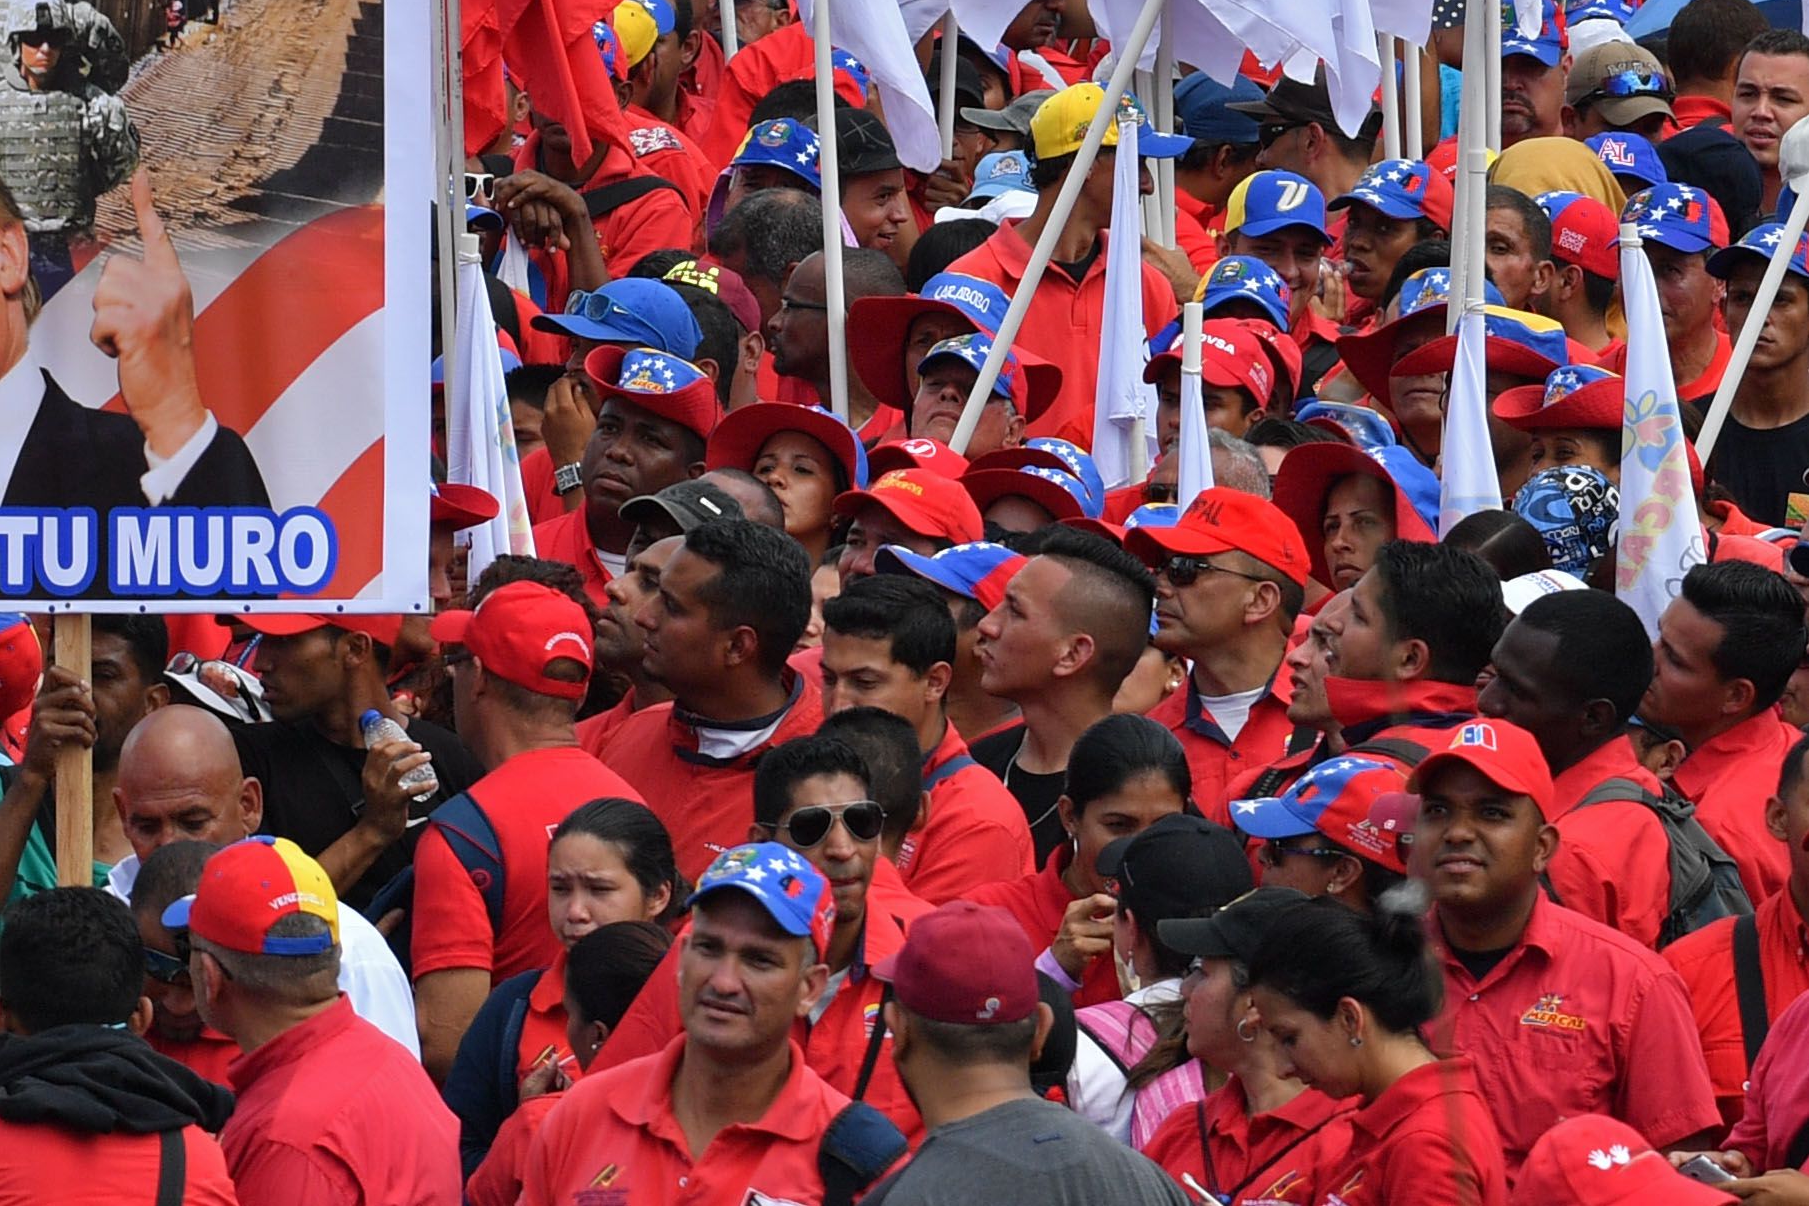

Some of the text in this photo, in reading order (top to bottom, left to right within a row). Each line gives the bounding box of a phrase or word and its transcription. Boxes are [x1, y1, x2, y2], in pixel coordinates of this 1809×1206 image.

[934, 284, 991, 314] CARABOBO
[113, 510, 332, 589] MURO
[1524, 1010, 1587, 1031] MERCAL
